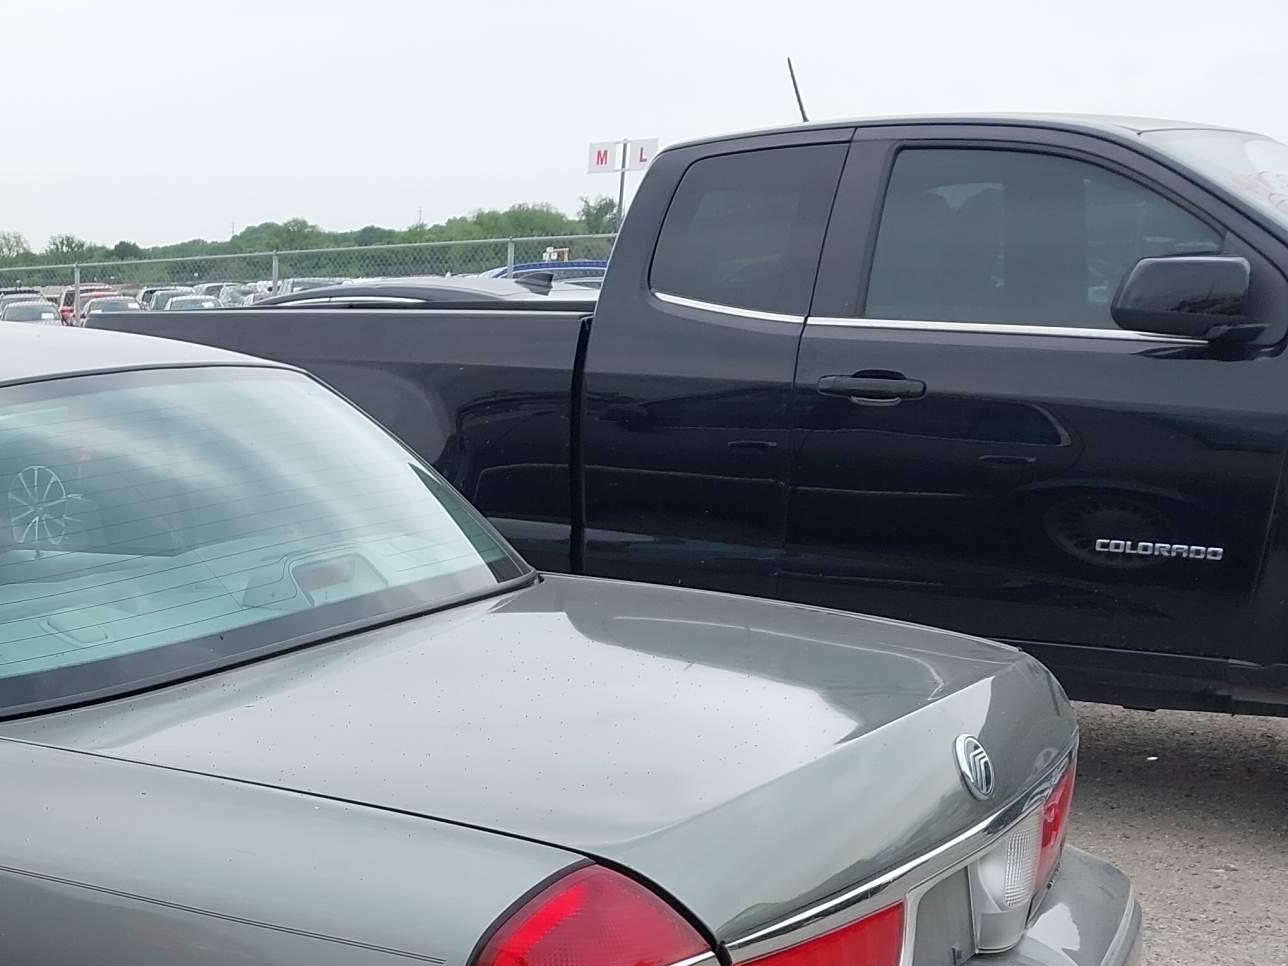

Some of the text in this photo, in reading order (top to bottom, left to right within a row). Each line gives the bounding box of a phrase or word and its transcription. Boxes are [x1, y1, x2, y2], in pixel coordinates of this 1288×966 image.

[596, 150, 609, 165] M
[639, 147, 648, 163] L
[1095, 538, 1224, 561] COLORADO
